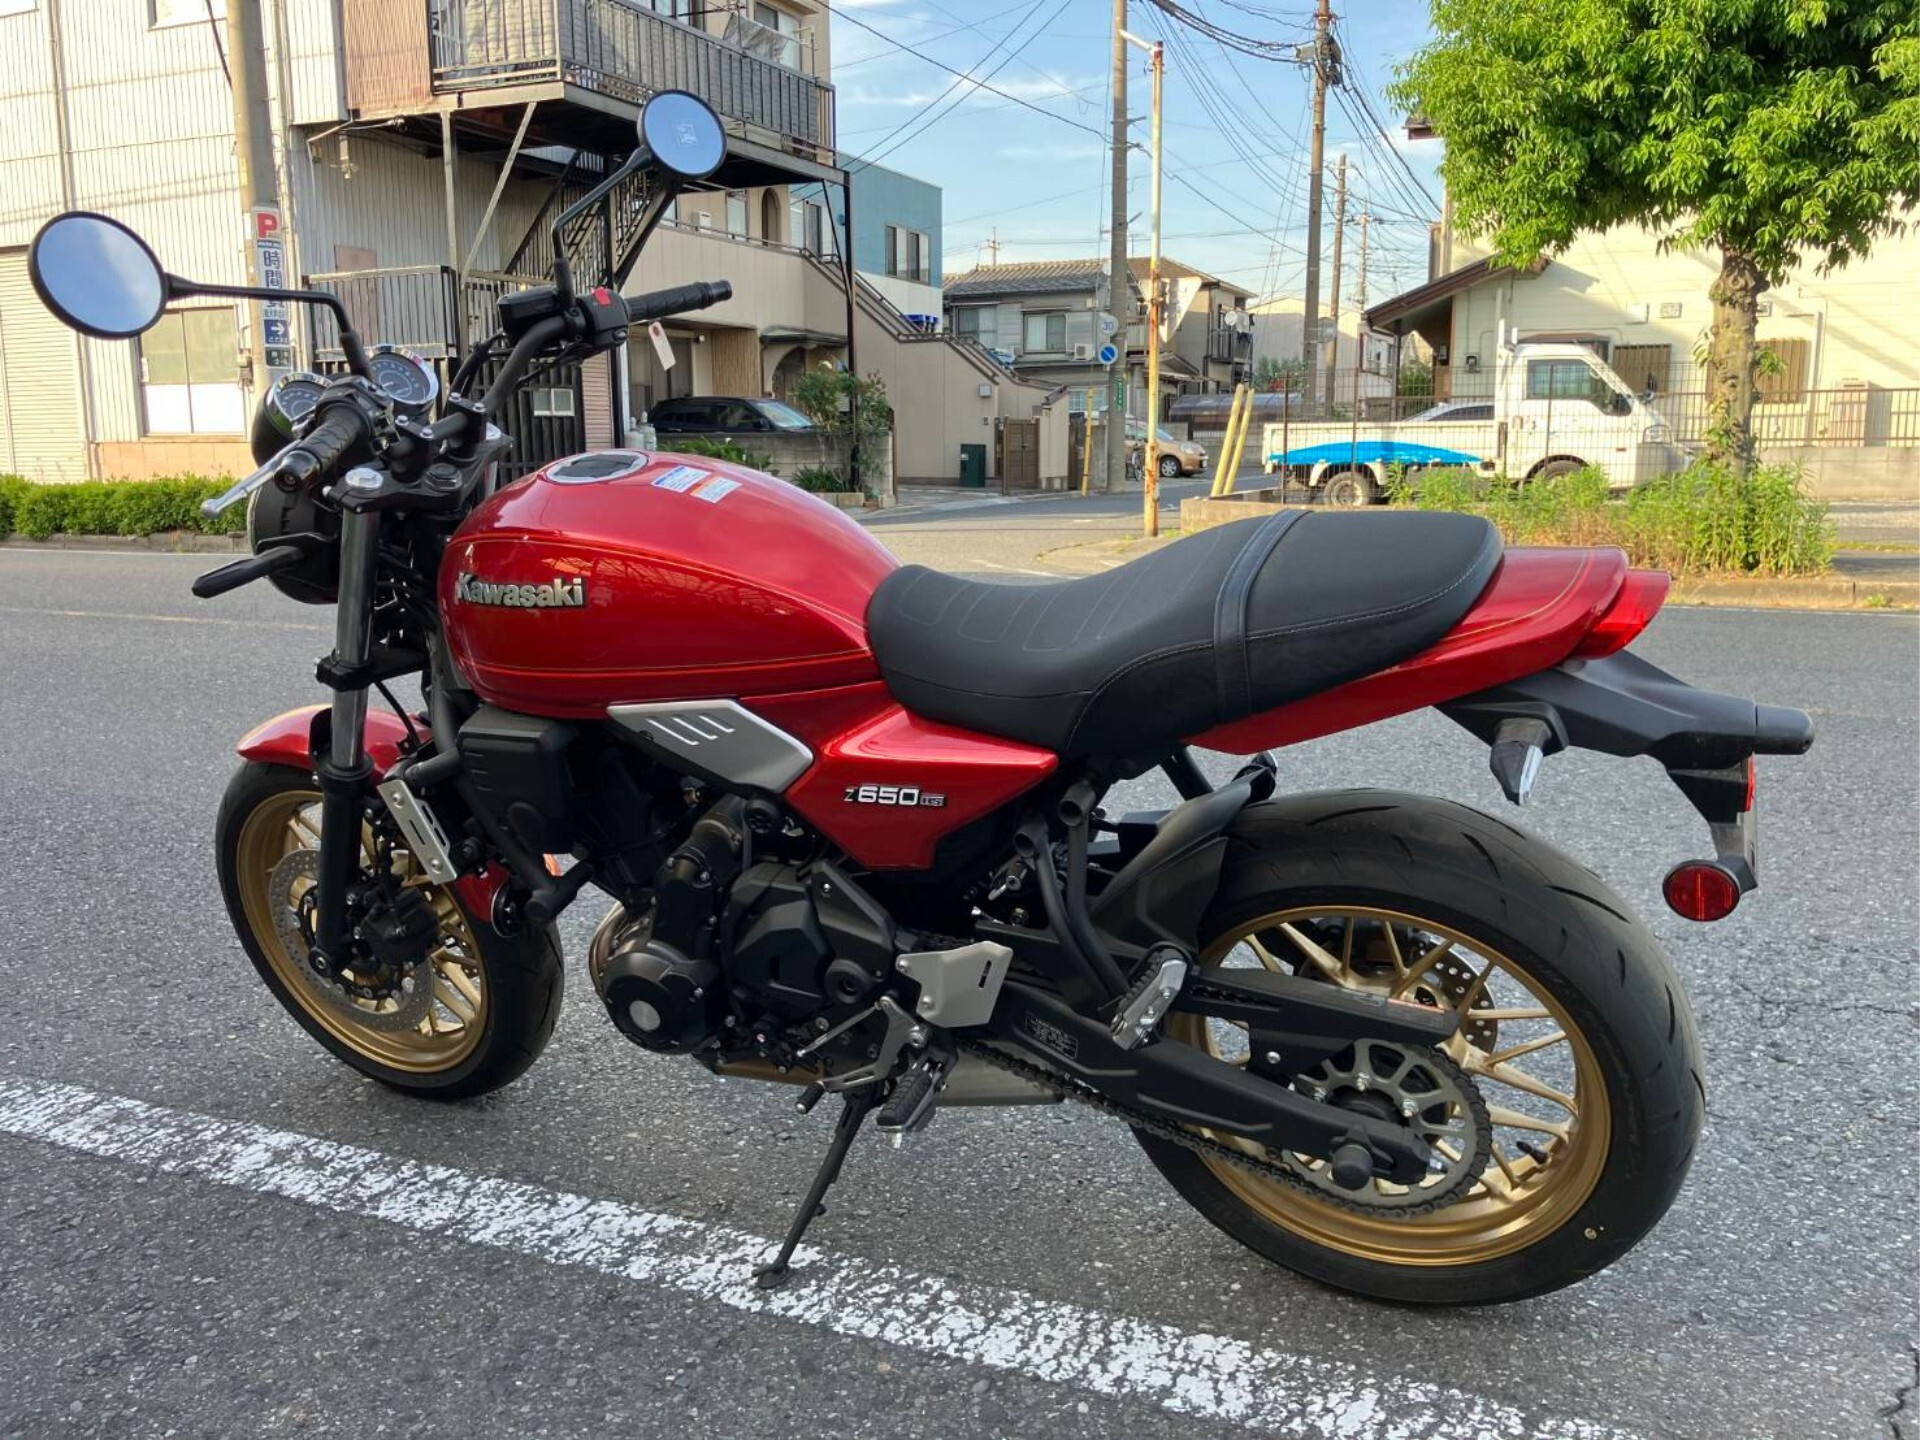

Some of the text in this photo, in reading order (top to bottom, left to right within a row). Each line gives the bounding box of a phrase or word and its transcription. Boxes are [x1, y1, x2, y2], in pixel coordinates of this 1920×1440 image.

[257, 213, 278, 239] P
[1103, 321, 1114, 331] 30
[456, 571, 583, 608] Kawasaki
